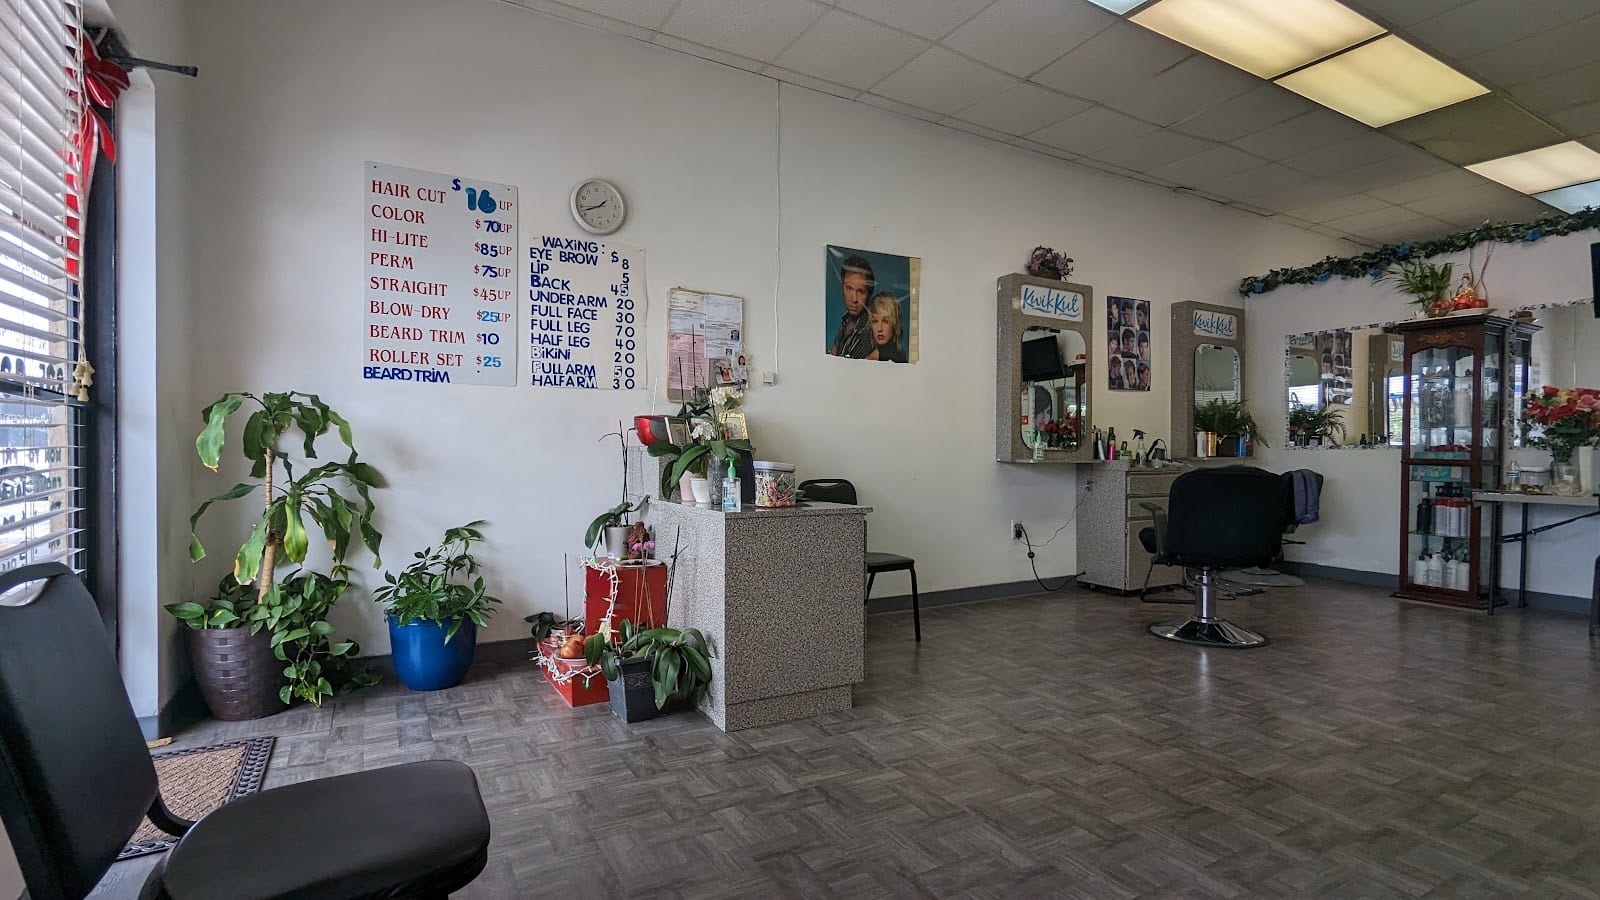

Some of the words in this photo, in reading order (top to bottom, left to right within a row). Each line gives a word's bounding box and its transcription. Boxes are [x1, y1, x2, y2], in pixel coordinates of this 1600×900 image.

[371, 179, 410, 198] HAIR
[417, 187, 447, 204] CUT
[371, 204, 425, 224] COLOR
[371, 228, 429, 248] HI-LITE
[370, 252, 414, 270] PERM
[529, 247, 552, 260] EYE
[559, 251, 598, 266] BROW
[370, 276, 448, 297] STRAIGHT
[530, 274, 571, 291] BACK
[622, 272, 630, 284] 5
[529, 289, 575, 306] UNDER
[577, 295, 608, 308] ARM
[616, 298, 634, 310] 20
[370, 300, 451, 321] BLOW-DRY
[531, 304, 562, 318] FULL
[567, 307, 598, 321] FACE
[615, 312, 635, 324] 30
[370, 324, 423, 341] BEARD
[429, 329, 466, 345] TRIM
[530, 319, 563, 332] FULL
[567, 321, 590, 334] LEG
[615, 325, 635, 338] 70
[531, 333, 563, 346] HALF
[568, 335, 590, 348] LEG
[615, 339, 635, 351] 40
[370, 348, 429, 366] ROLLER
[436, 353, 464, 367] SET
[614, 351, 635, 364] 20
[363, 366, 412, 380] BEARD
[531, 360, 563, 375] FULL
[565, 363, 596, 377] ARM
[614, 365, 635, 378] 50
[612, 378, 635, 390] 30
